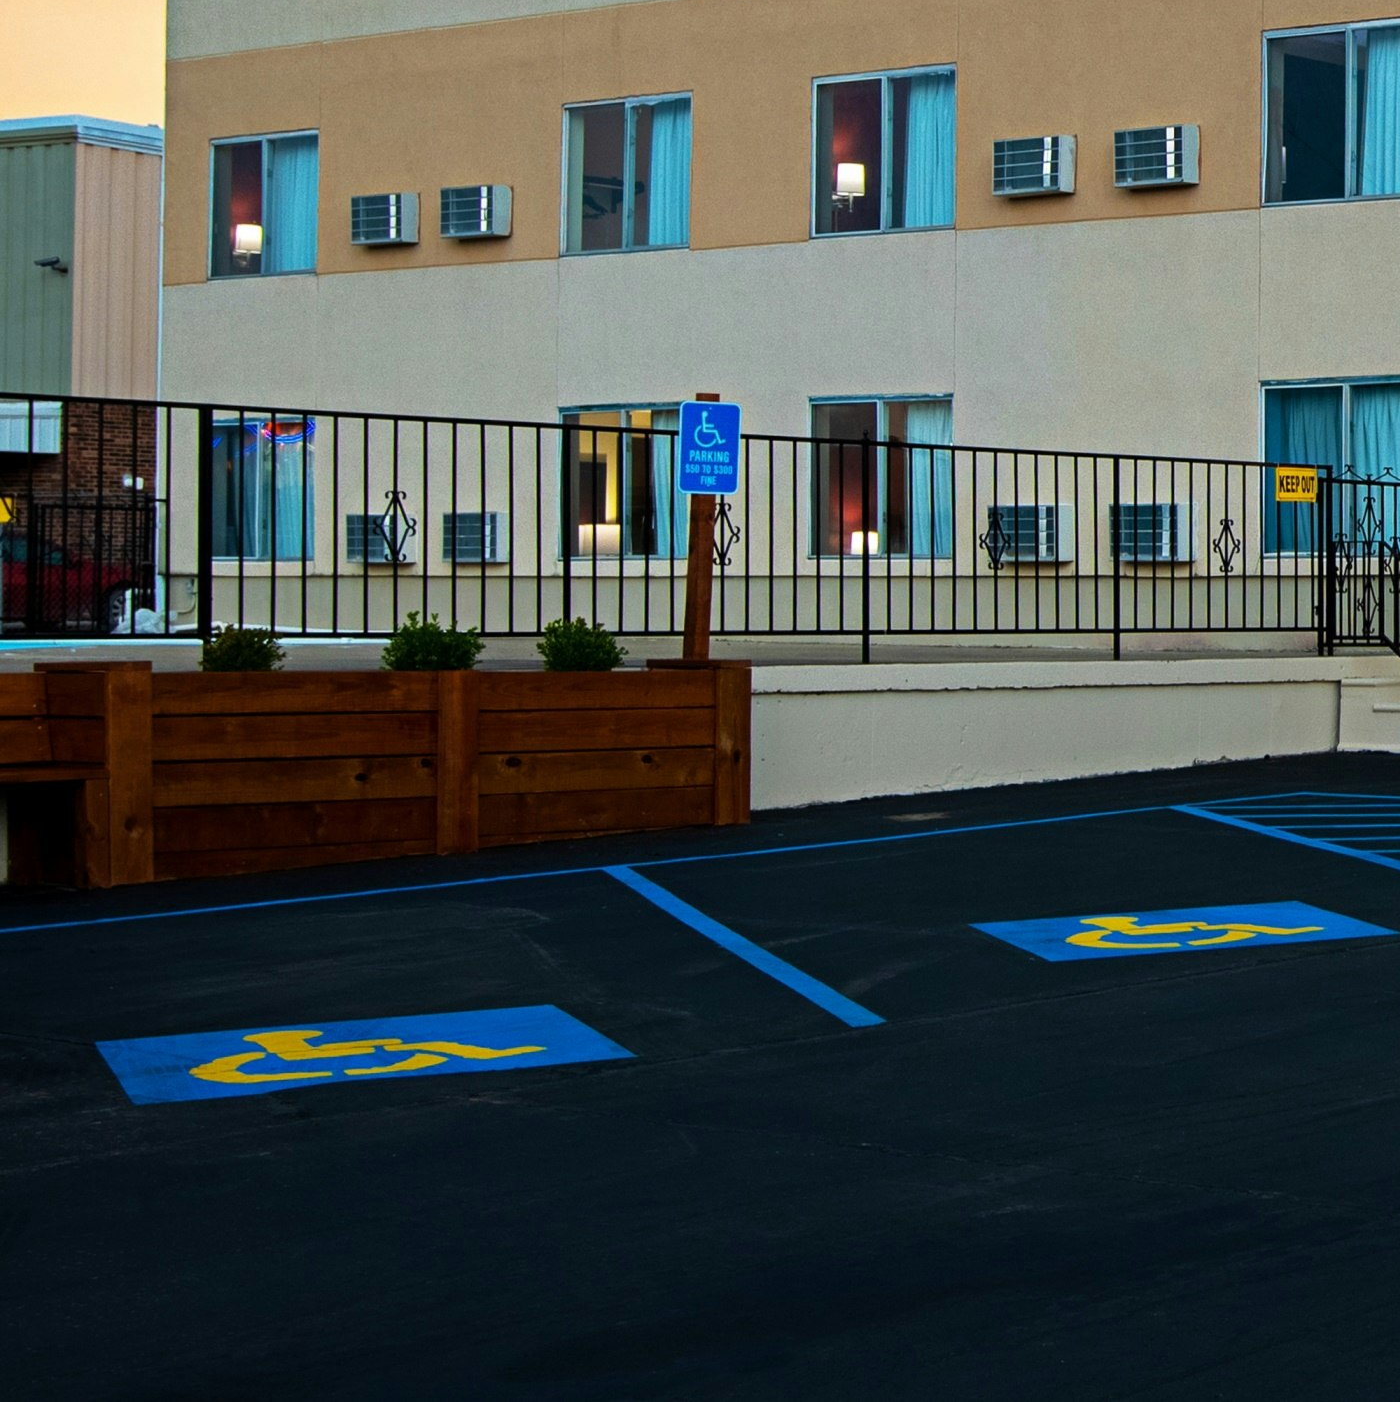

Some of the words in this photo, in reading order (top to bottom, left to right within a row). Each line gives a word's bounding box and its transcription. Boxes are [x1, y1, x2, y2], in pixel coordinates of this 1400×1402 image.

[689, 450, 730, 463] PARKING
[685, 464, 700, 473] $50
[702, 464, 711, 474] TO
[700, 476, 717, 485] FINE
[1280, 475, 1300, 493] KEEP
[1301, 476, 1315, 493] OUT
